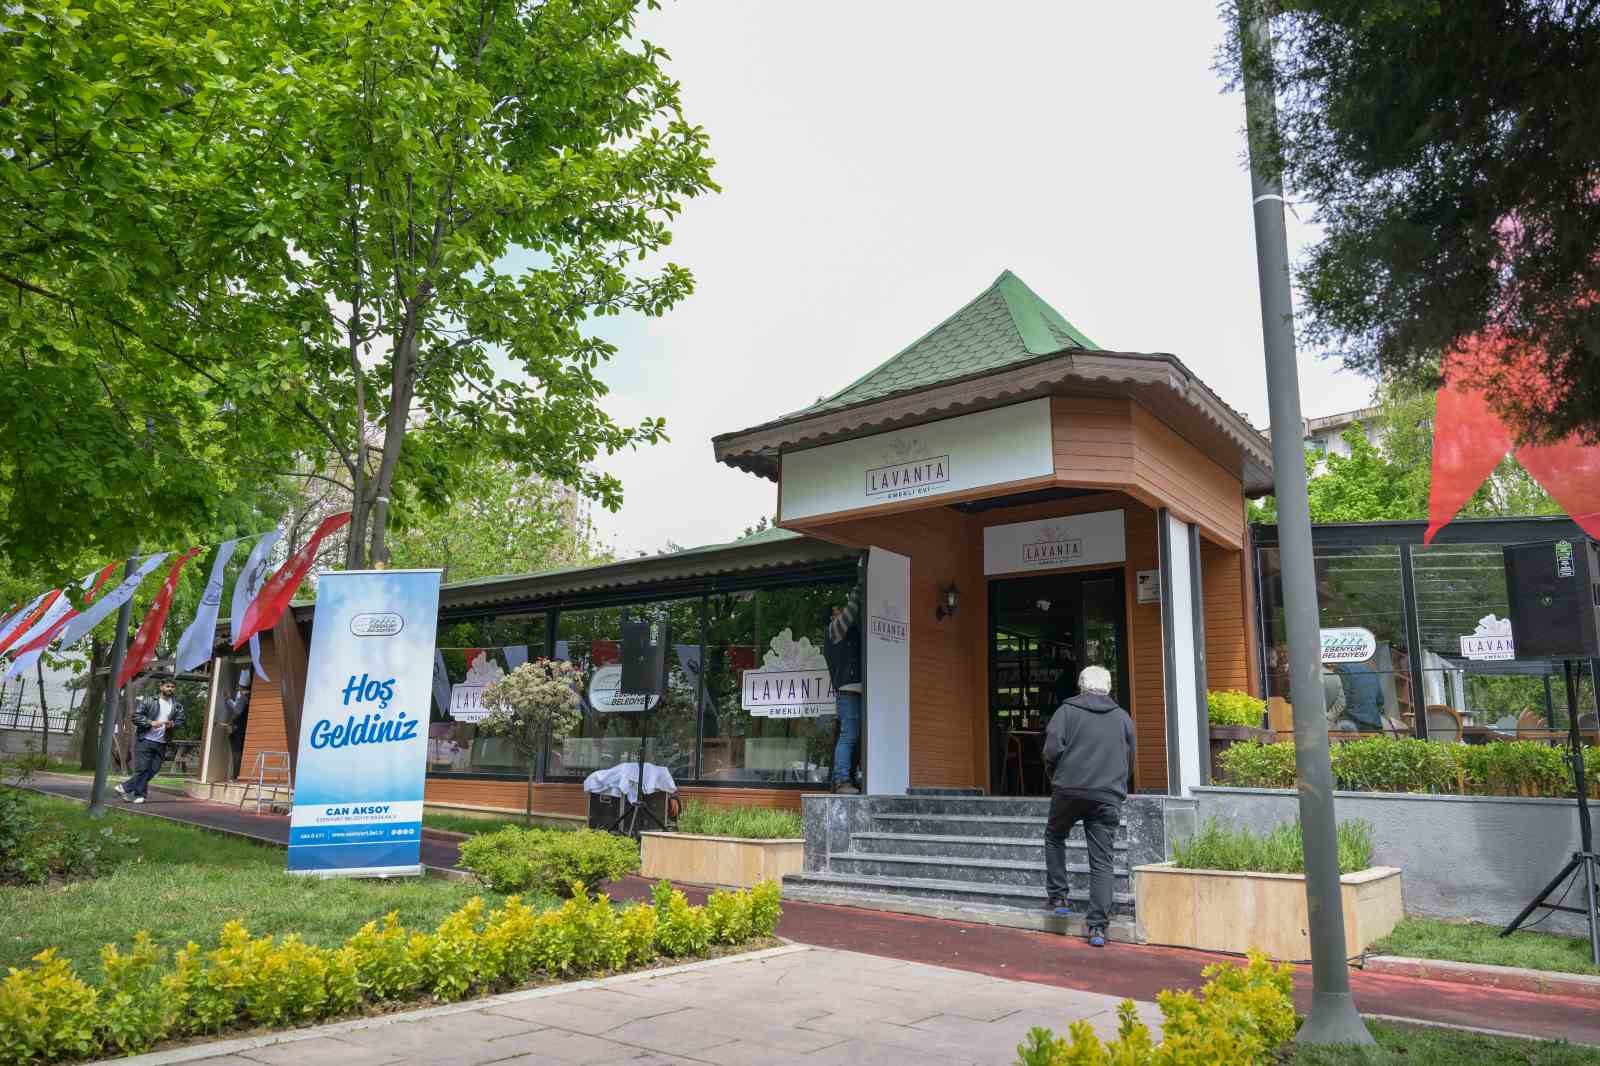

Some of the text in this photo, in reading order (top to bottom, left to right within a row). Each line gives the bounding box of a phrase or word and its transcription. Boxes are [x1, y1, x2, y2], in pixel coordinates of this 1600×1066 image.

[871, 463, 944, 491] LAVANTA
[1026, 543, 1079, 561] LAVANTA
[1469, 639, 1515, 652] LAVAN
[342, 673, 396, 709] Hoş
[310, 712, 418, 749] Geldiniz
[326, 805, 390, 816] CAN AKSOY
